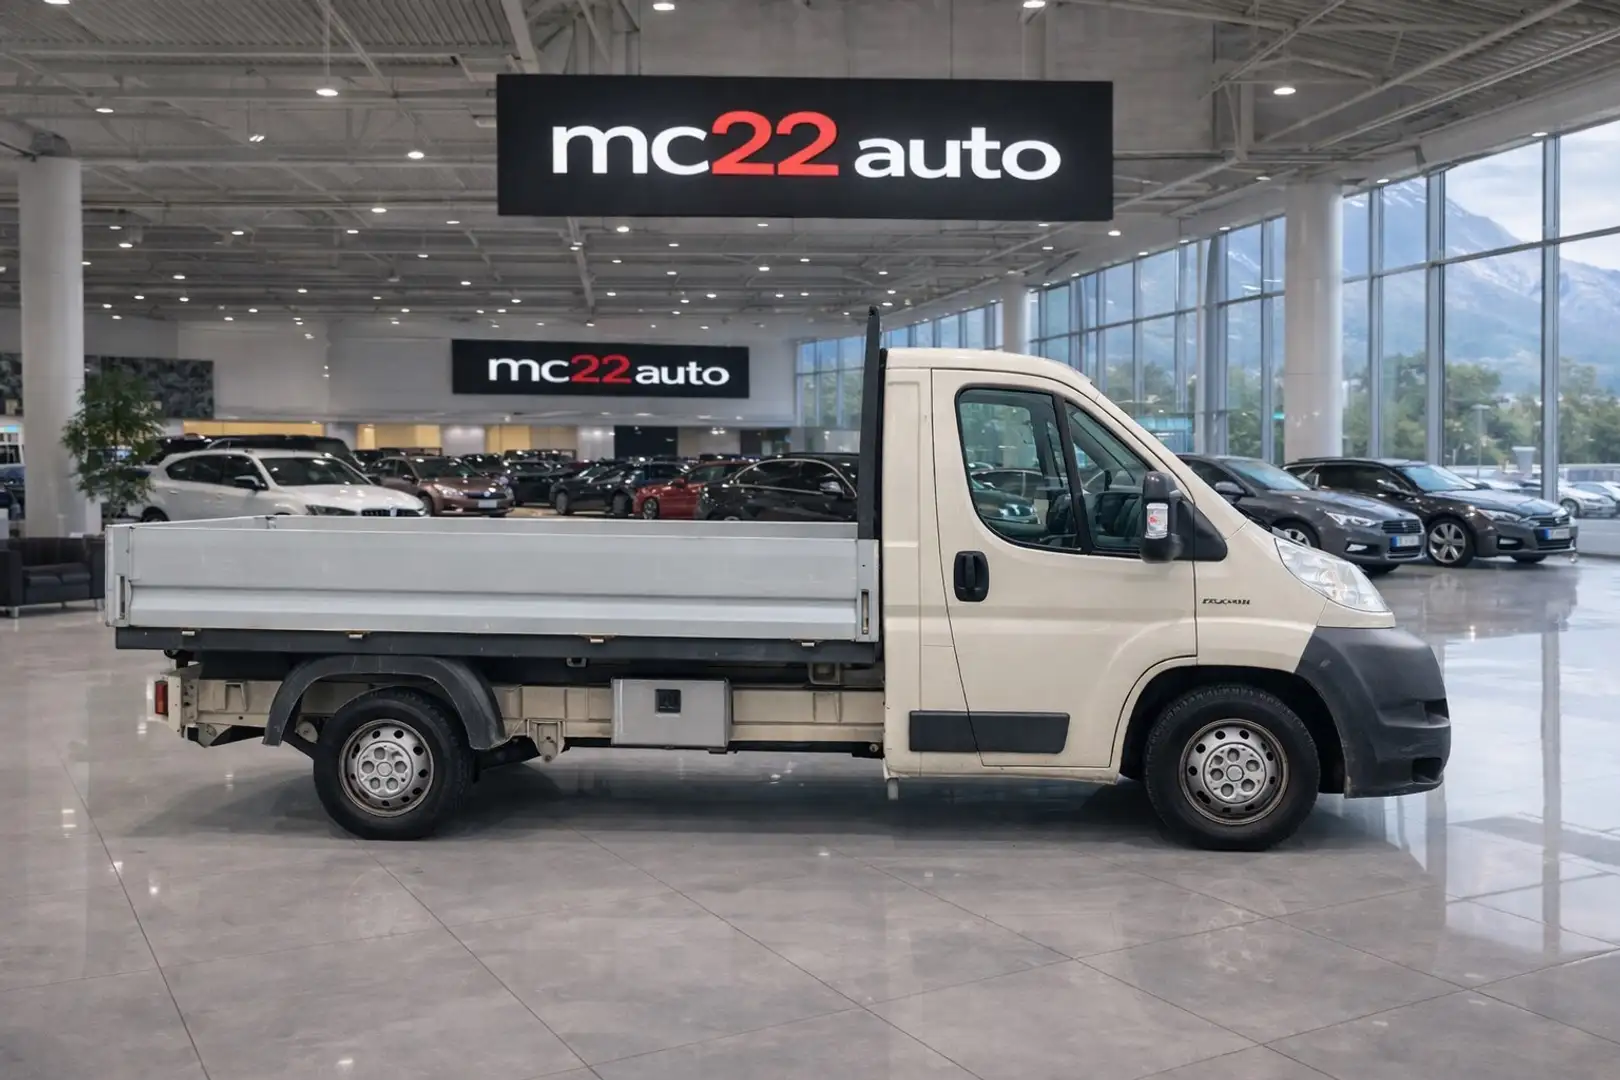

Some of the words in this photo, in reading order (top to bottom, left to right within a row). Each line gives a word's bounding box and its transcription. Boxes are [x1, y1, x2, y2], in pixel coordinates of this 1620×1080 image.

[552, 111, 839, 176] mc22
[855, 127, 1061, 180] auto
[488, 355, 631, 383] mc22
[635, 361, 730, 385] auto
